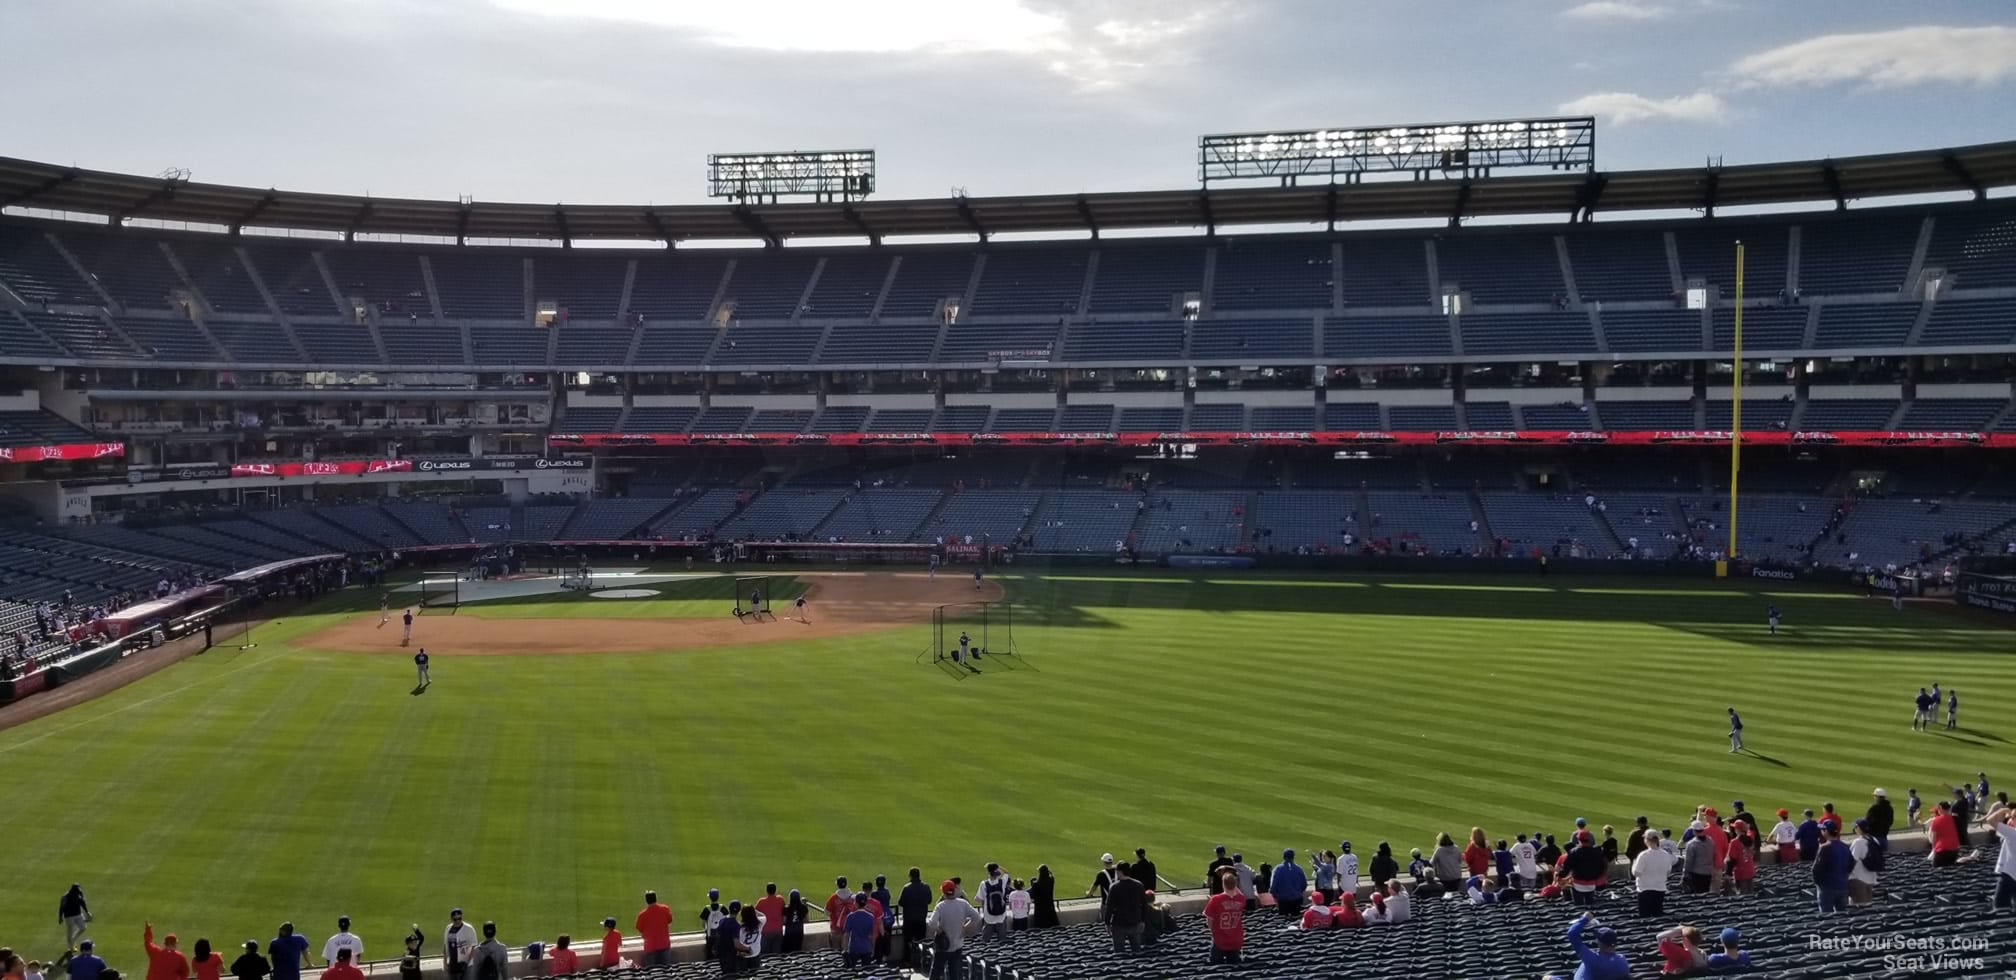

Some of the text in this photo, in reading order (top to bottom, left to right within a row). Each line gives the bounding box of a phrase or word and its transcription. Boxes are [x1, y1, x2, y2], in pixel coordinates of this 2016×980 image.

[192, 469, 229, 477] LEXUS
[1753, 567, 1795, 580] Fanatics
[1873, 576, 1897, 590] odelo
[1347, 864, 1358, 875] 22
[1219, 912, 1242, 930] 27
[744, 931, 759, 945] 27
